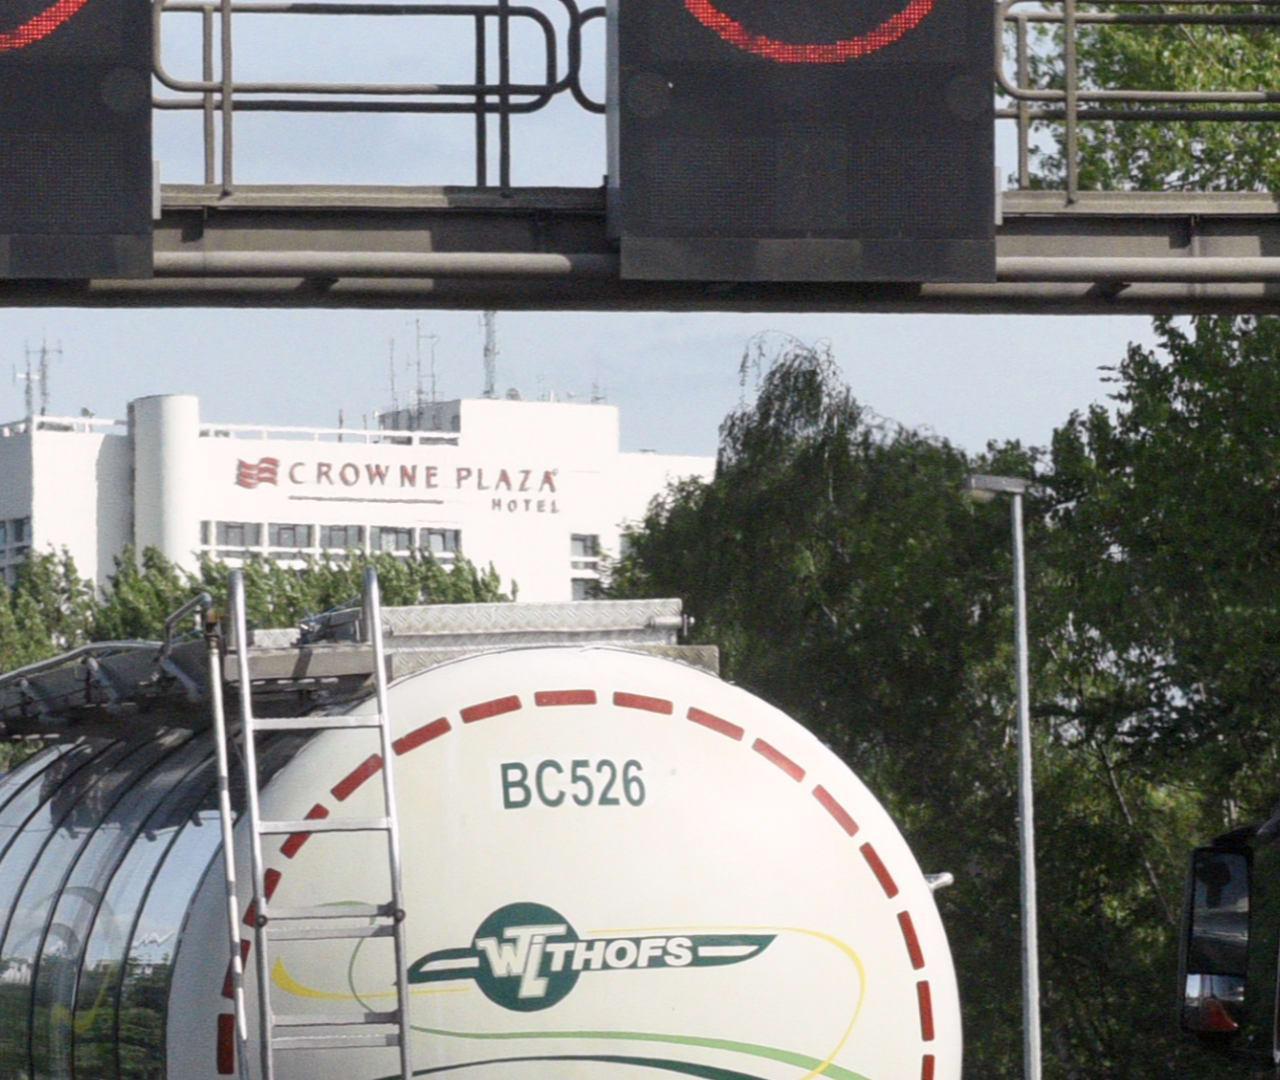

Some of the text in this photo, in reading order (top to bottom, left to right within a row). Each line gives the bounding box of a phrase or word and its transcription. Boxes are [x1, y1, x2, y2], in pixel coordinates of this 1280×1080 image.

[288, 462, 556, 493] CROWNE PLAZA
[491, 498, 559, 514] HOTEL
[500, 759, 646, 810] BC526
